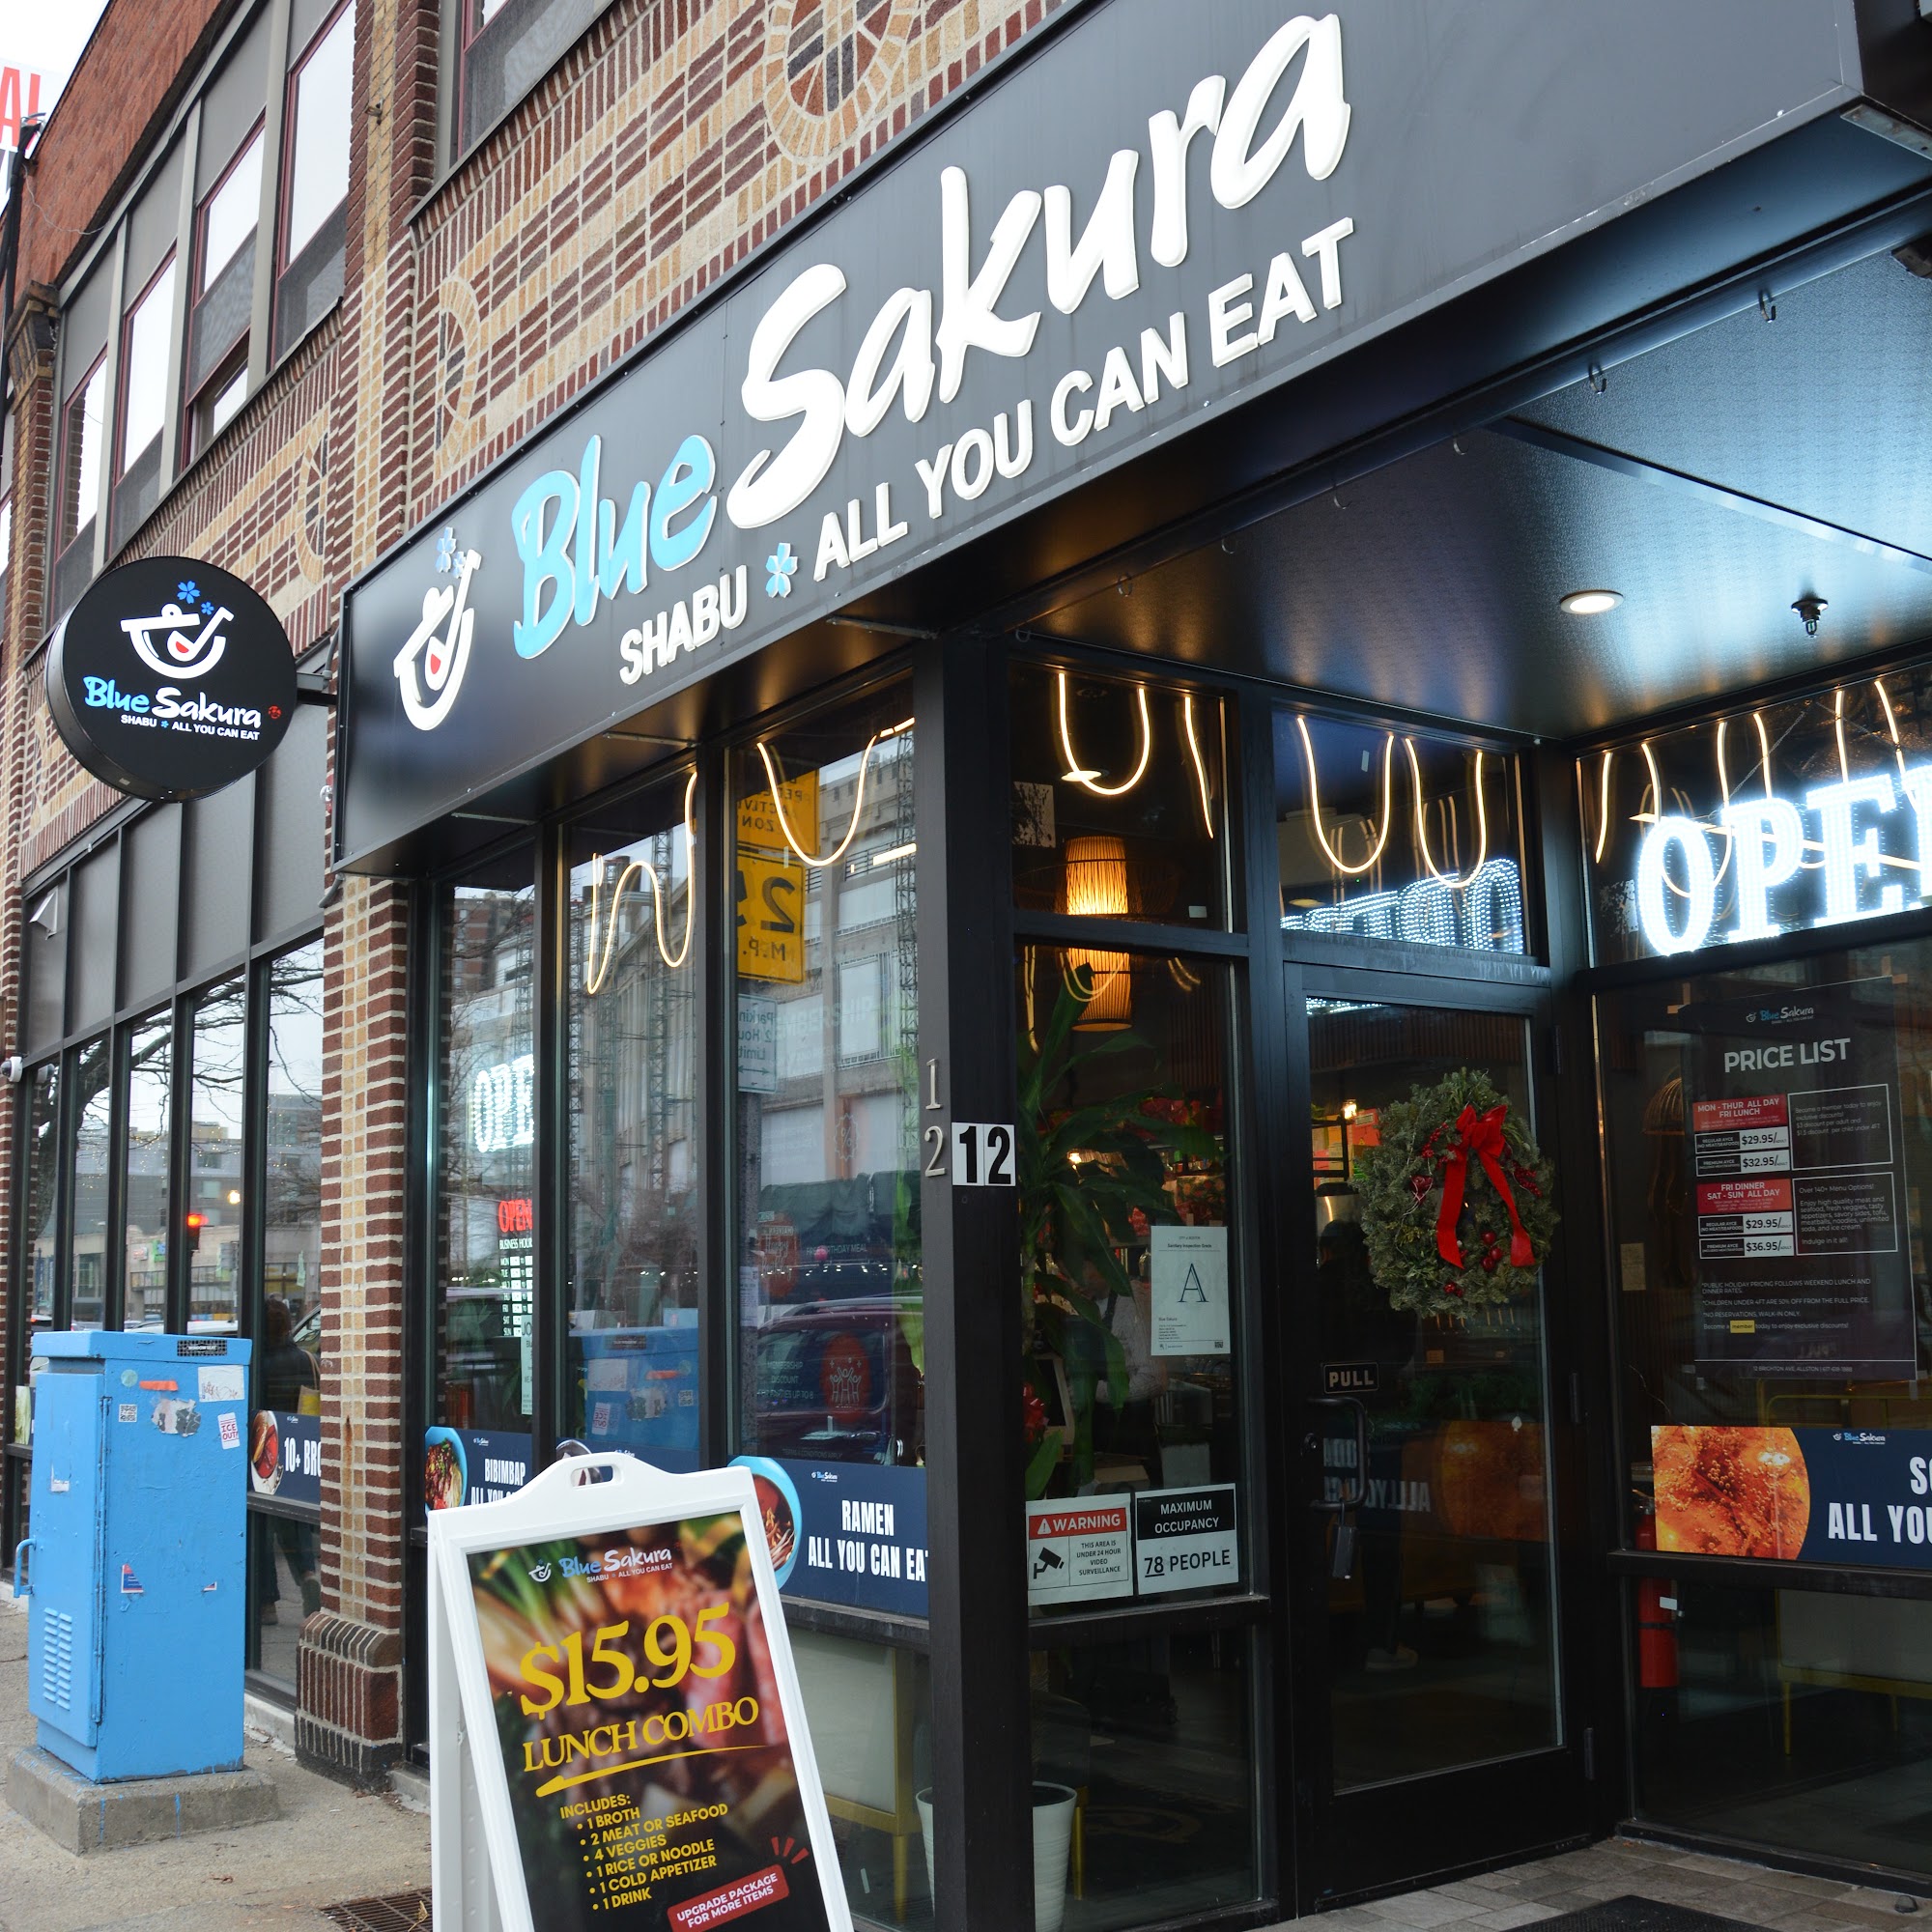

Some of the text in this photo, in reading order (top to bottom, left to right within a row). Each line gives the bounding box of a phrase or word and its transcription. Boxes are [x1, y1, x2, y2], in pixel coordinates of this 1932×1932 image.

[512, 13, 1350, 660] Blue Sakura
[619, 218, 1353, 685] SHABU ALL YOU CAN EAT
[83, 676, 262, 728] Blue Sakura
[121, 715, 260, 740] SHABU ALL YOU CAN EAT
[1723, 1037, 1851, 1073] PRICE LIST
[1722, 1101, 1744, 1110] THUR
[1747, 1099, 1762, 1108] ALL
[1733, 1108, 1760, 1117] LUNCH
[959, 1126, 1011, 1184] 12
[1735, 1181, 1765, 1190] DINNER
[1833, 1197, 1854, 1206] quality
[498, 1199, 533, 1233] OPEN
[499, 1238, 518, 1250] BUSINESS
[1802, 1237, 1825, 1246] Indulge
[1178, 1263, 1209, 1303] A
[1329, 1370, 1374, 1388] PULL
[284, 1437, 300, 1473] 10+
[485, 1459, 526, 1486] BIBIMBAP
[842, 1500, 895, 1536] RAMEN
[1160, 1499, 1212, 1515] MAXIMUM
[1052, 1514, 1121, 1531] WARNING
[1154, 1517, 1219, 1534] OCCUPANCY
[1828, 1502, 1878, 1542] ALL
[558, 1548, 671, 1577] Blue Sakura
[809, 1536, 928, 1582] ALL YOU CAN EA
[1079, 1566, 1121, 1577] SURVEILLANCE
[1145, 1549, 1231, 1577] 78 PEOPLE
[586, 1574, 609, 1583] SHABU
[520, 1602, 736, 1719] $15.95
[523, 1696, 759, 1772] LUNCH COMBO
[560, 1794, 631, 1819] INCLUDES:
[587, 1807, 640, 1830] 1 BROTH
[590, 1804, 728, 1846] 2 MEAT OR SEAFOOD
[594, 1834, 667, 1861] 4 VEGGIES
[596, 1838, 715, 1878] 1 RICE OR NOODLE
[600, 1855, 717, 1893] 1 COLD APPETIZER
[603, 1887, 652, 1910] 1 DRINK
[676, 1872, 778, 1921] UPGRADE PACKAGE
[687, 1886, 774, 1928] FOR MORE ITEMS
